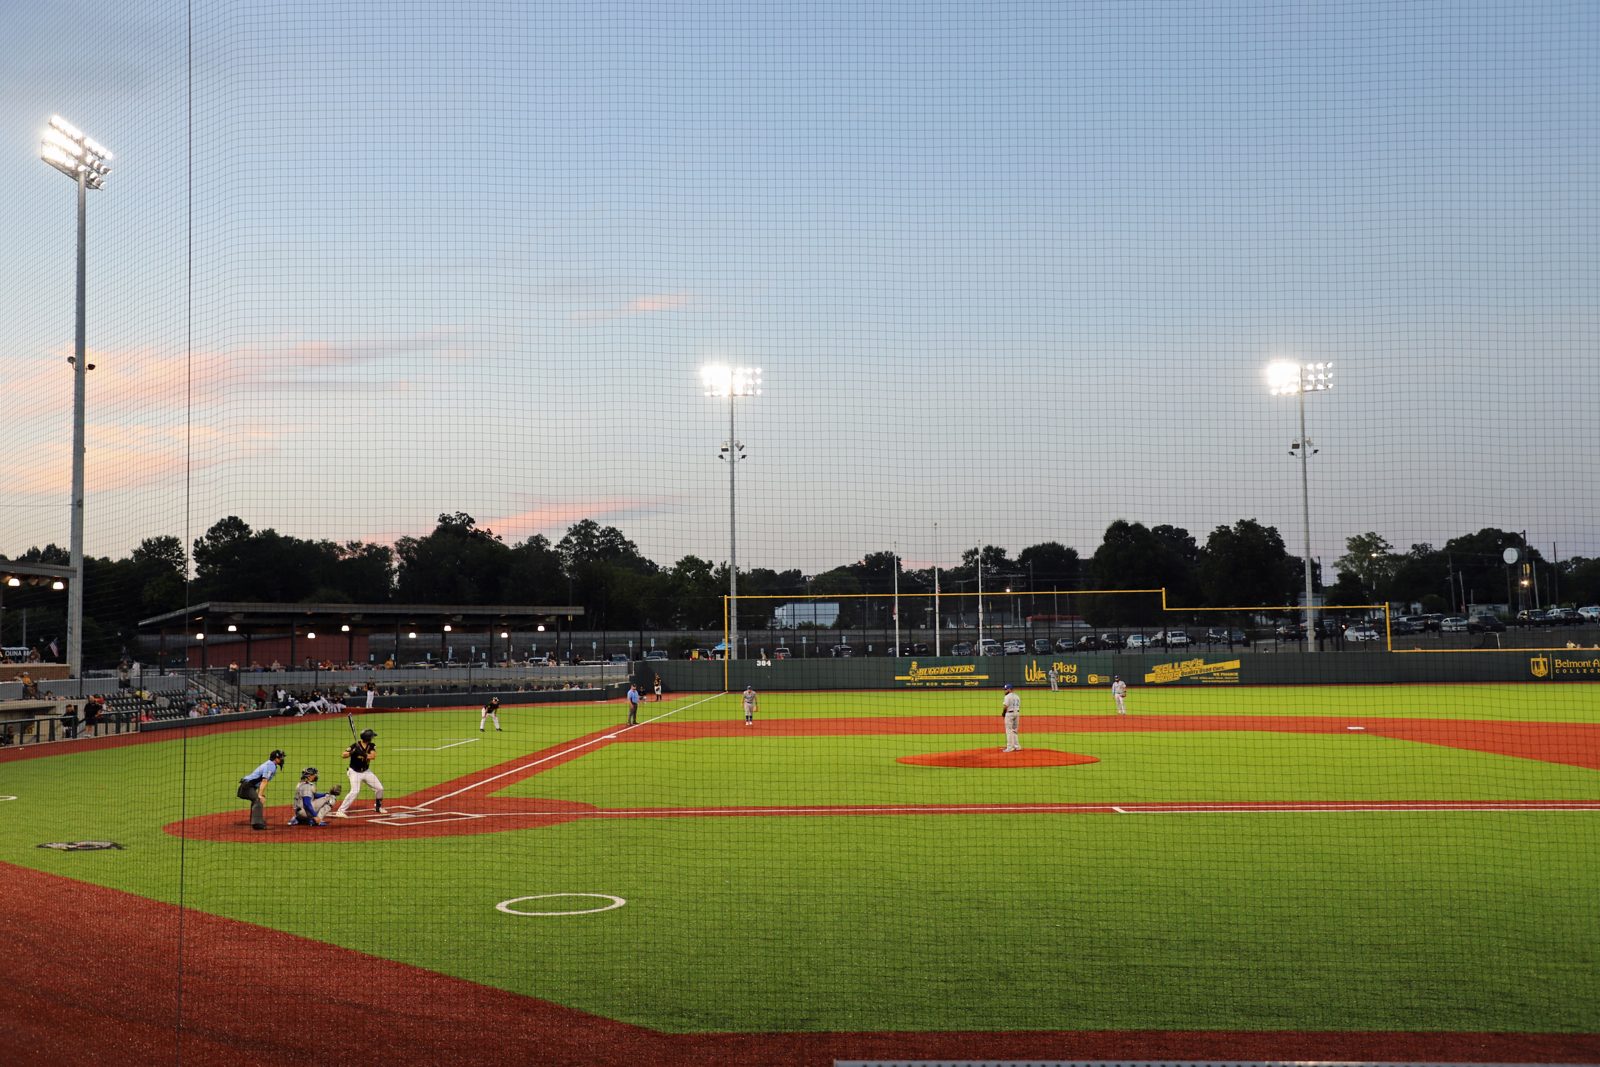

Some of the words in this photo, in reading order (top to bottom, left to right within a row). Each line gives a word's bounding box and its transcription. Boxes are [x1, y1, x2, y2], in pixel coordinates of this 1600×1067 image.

[1053, 661, 1077, 673] Play
[1555, 659, 1591, 668] Belmont
[939, 664, 976, 675] BUSTERS
